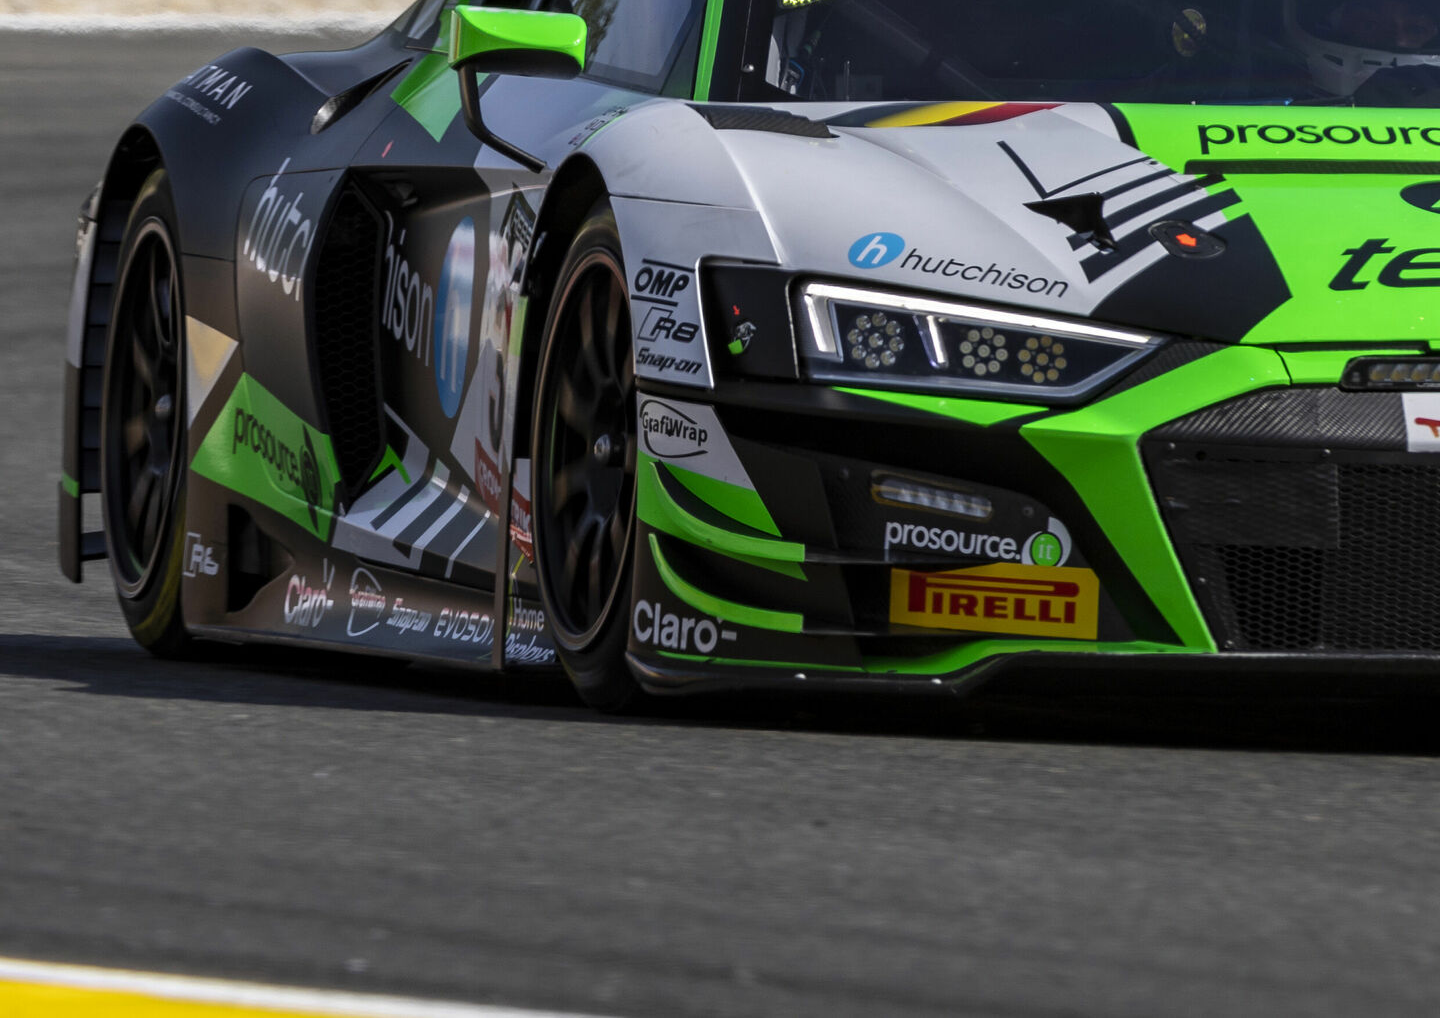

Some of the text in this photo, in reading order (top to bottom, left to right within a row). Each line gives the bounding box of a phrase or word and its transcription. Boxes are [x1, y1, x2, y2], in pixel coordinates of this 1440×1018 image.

[634, 267, 690, 298] OMP
[900, 248, 1070, 299] hutchison
[637, 347, 702, 376] Snap-on
[642, 412, 708, 447] GrafiWrap
[908, 571, 1080, 624] PIRELLI
